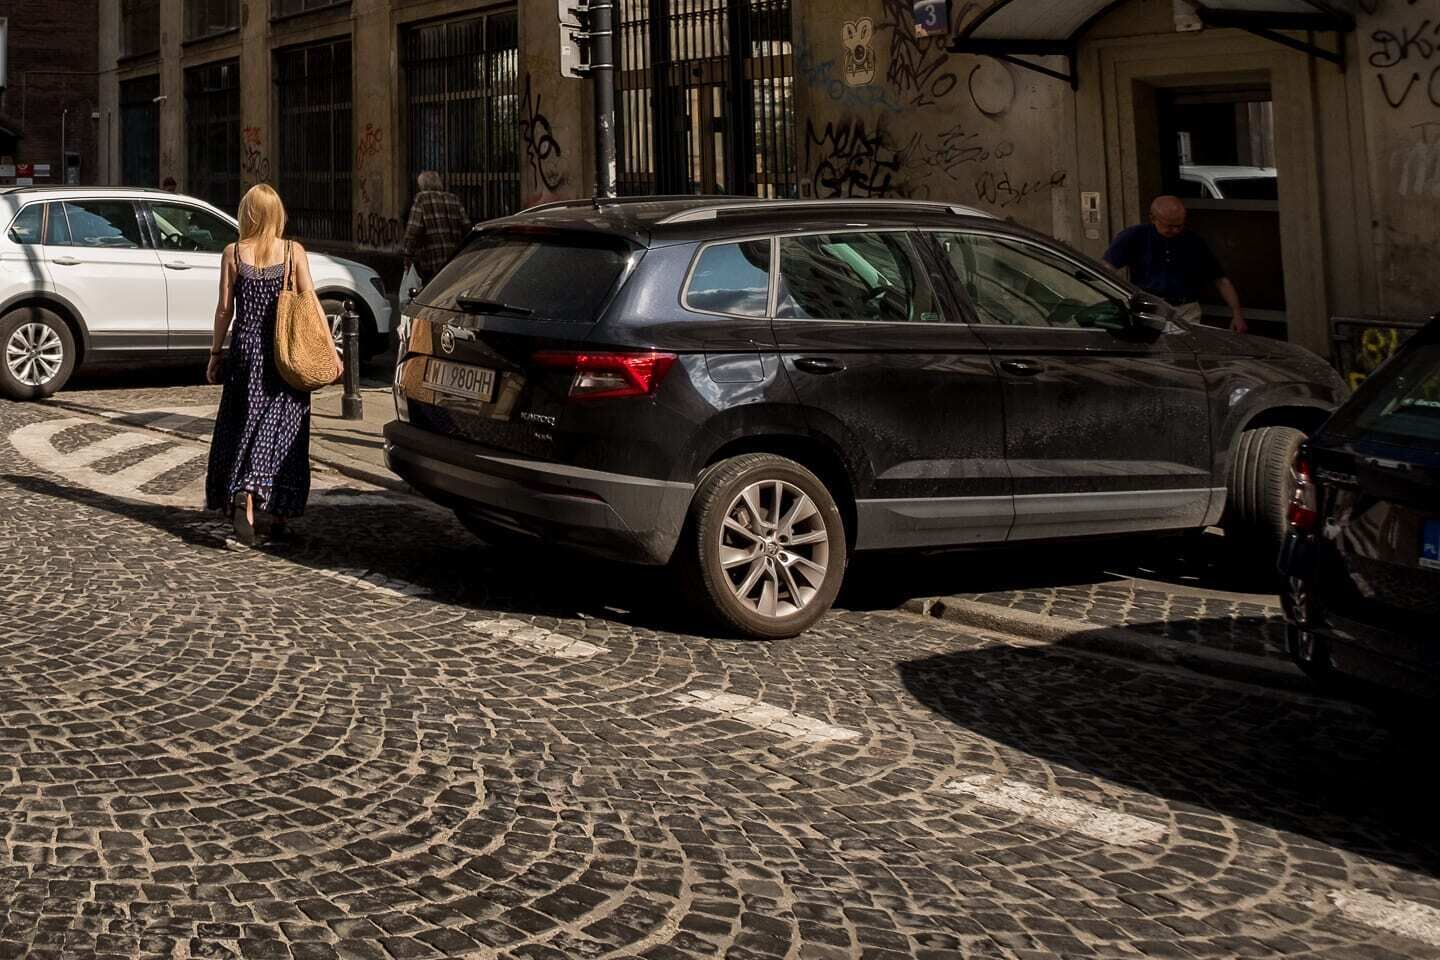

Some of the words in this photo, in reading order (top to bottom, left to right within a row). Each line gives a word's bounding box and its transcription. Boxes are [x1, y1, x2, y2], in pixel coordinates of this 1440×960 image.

[924, 4, 937, 26] 3
[430, 360, 445, 385] WI
[450, 366, 493, 394] 980HH
